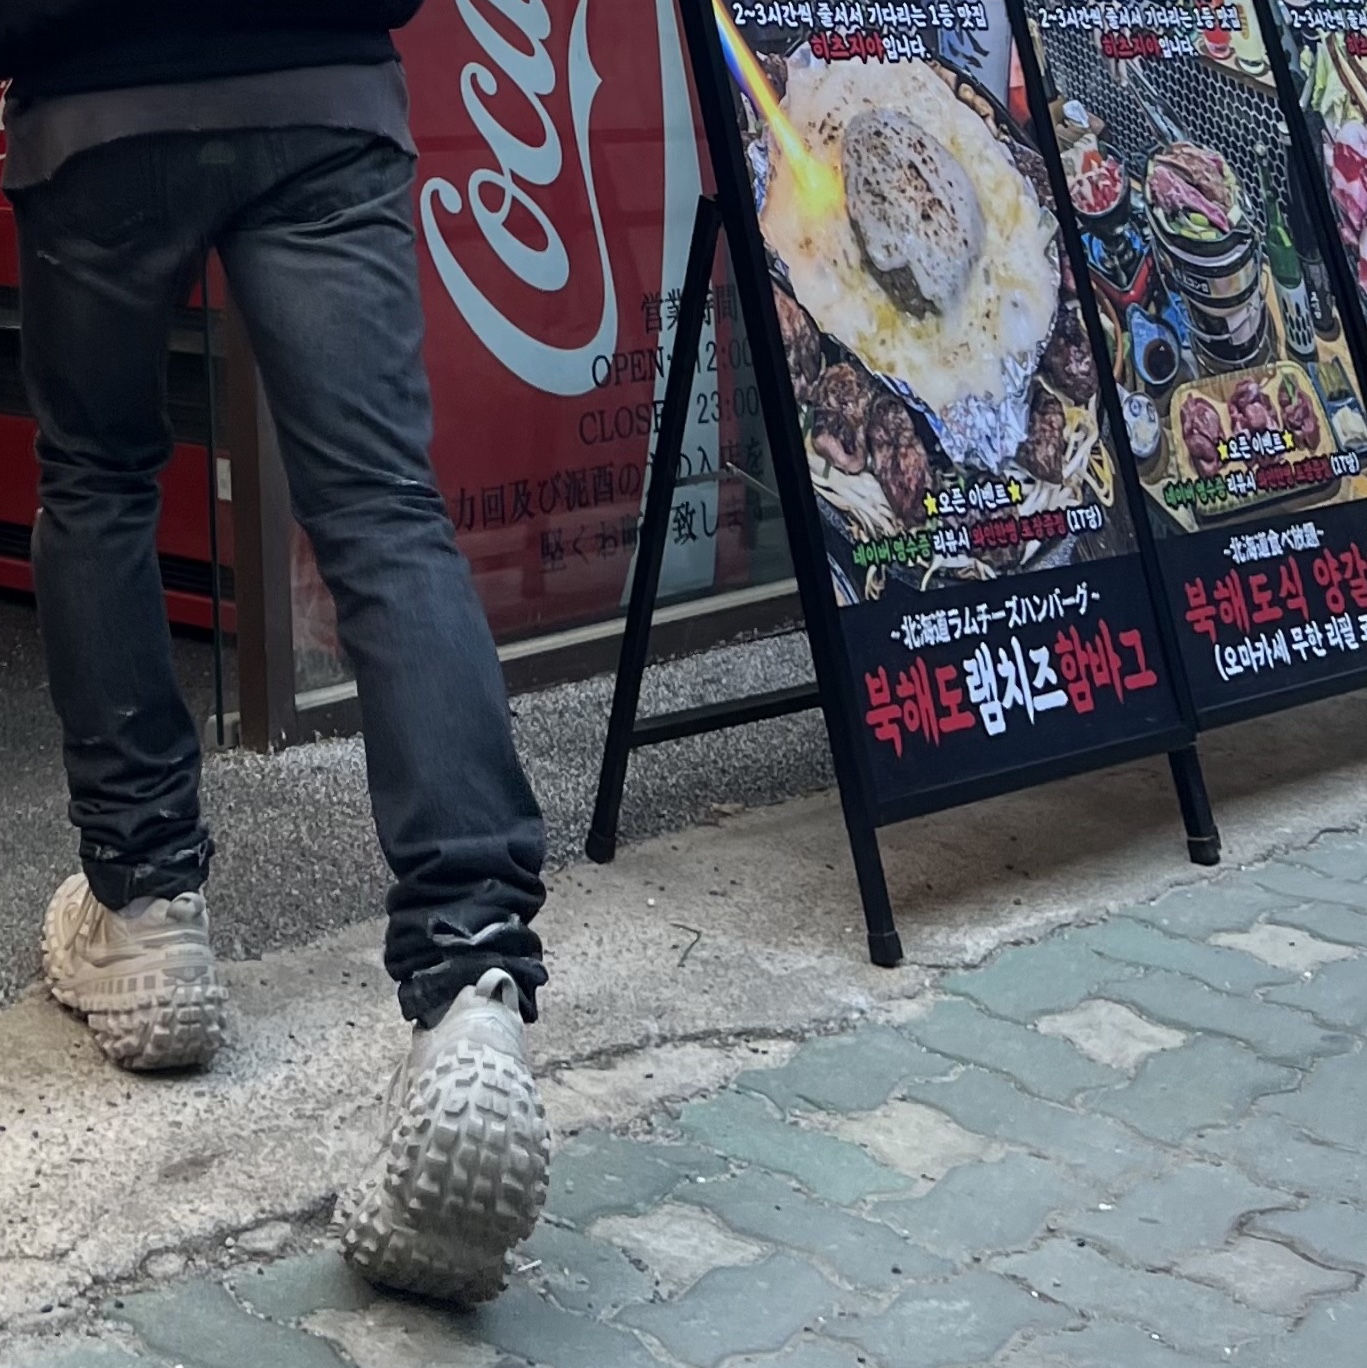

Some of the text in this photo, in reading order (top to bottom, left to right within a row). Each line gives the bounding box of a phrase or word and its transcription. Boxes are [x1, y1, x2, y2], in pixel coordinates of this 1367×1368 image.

[732, 2, 987, 29] 2~3시간씩 줄서서 기다리는 1등 맛집
[1039, 6, 1242, 30] 2~3시간씩 줄서서 기다리는 1등 맛집
[1229, 431, 1285, 460] 오픈 이벤트
[939, 480, 1011, 514] 오픈 이벤트
[853, 538, 891, 567] 네이버
[894, 534, 931, 562] 영수증
[933, 525, 970, 553] 리뷰시
[1185, 555, 1310, 644] 북해도식
[1215, 629, 1292, 681] (오마카세
[1292, 621, 1327, 661] 무한
[1328, 612, 1353, 653] 리필
